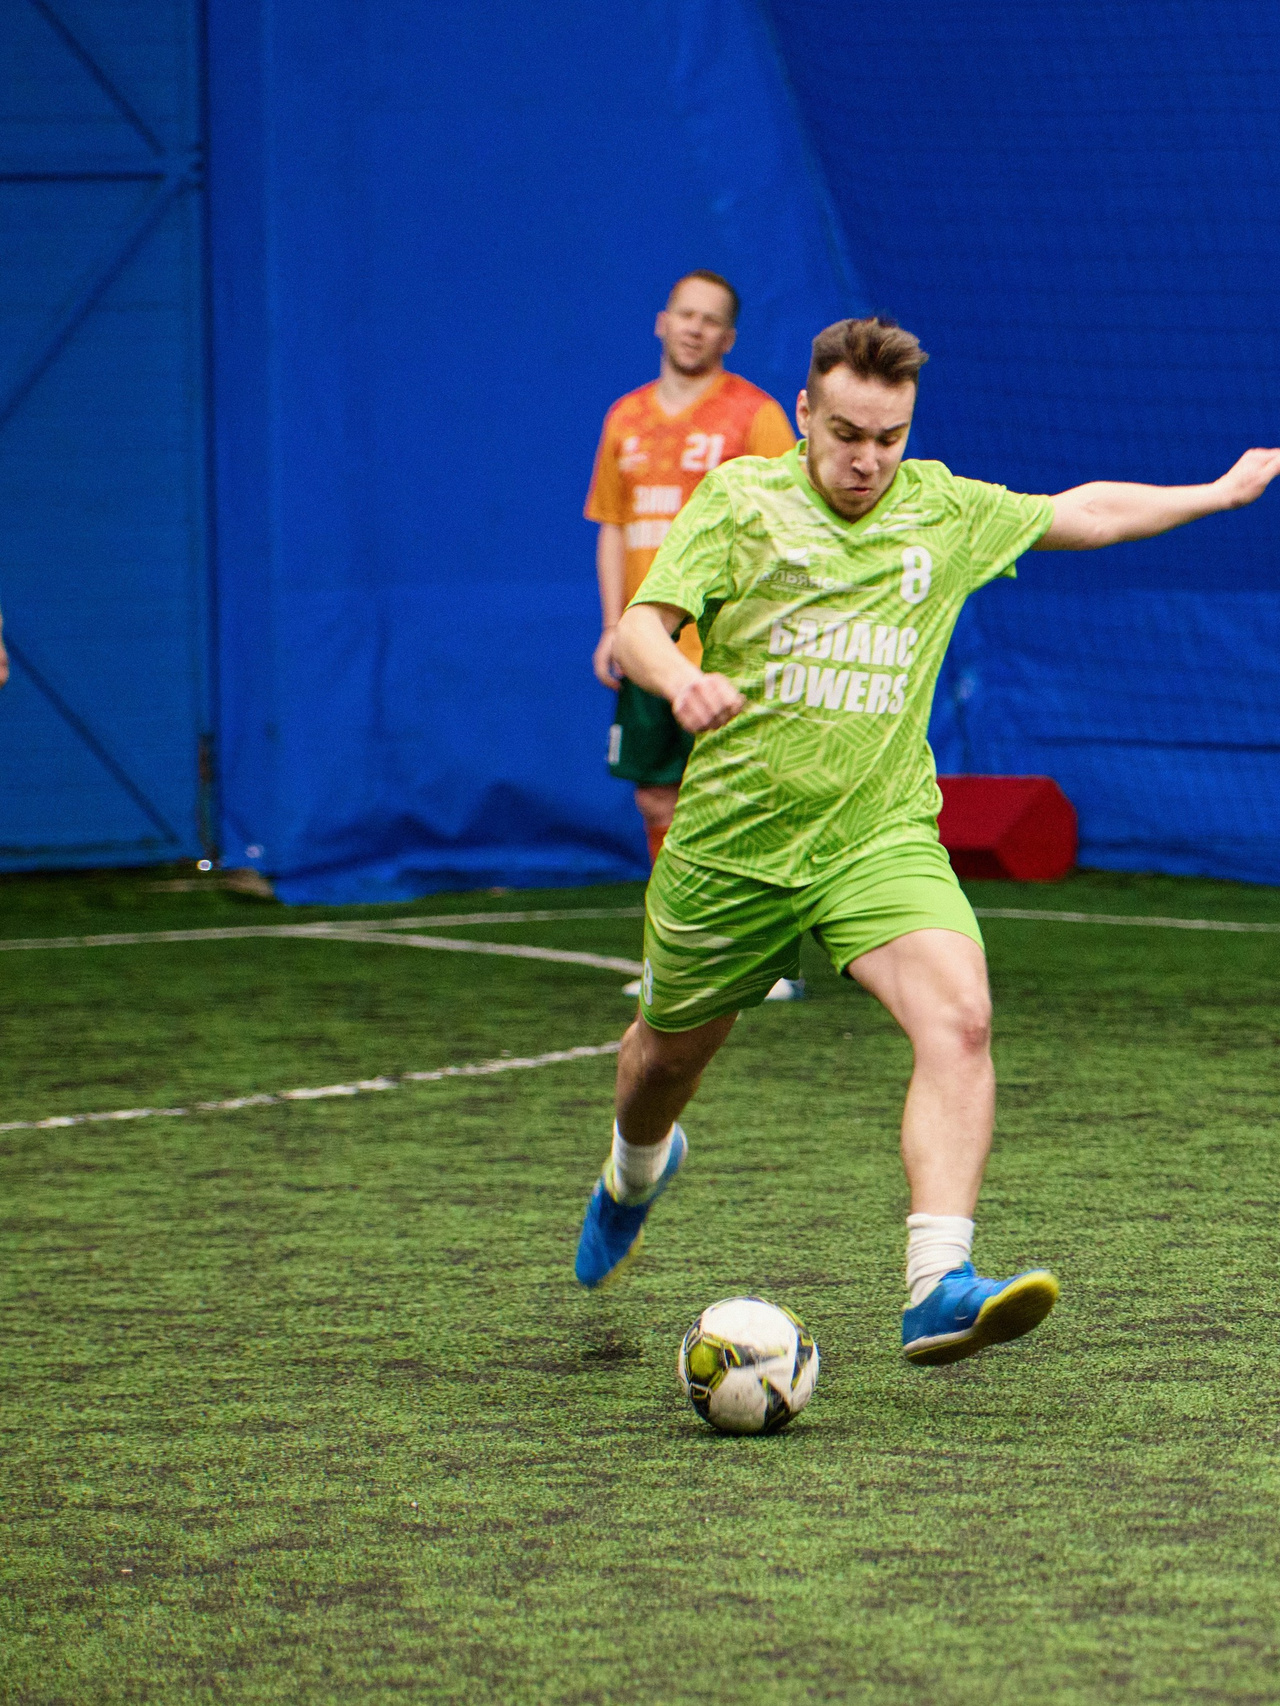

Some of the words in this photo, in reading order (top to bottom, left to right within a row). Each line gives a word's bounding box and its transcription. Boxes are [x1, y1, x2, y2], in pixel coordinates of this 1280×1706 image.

[681, 432, 726, 471] 21
[900, 545, 933, 604] 8
[768, 617, 919, 668] БАЛАНС
[764, 662, 909, 715] TOWERS
